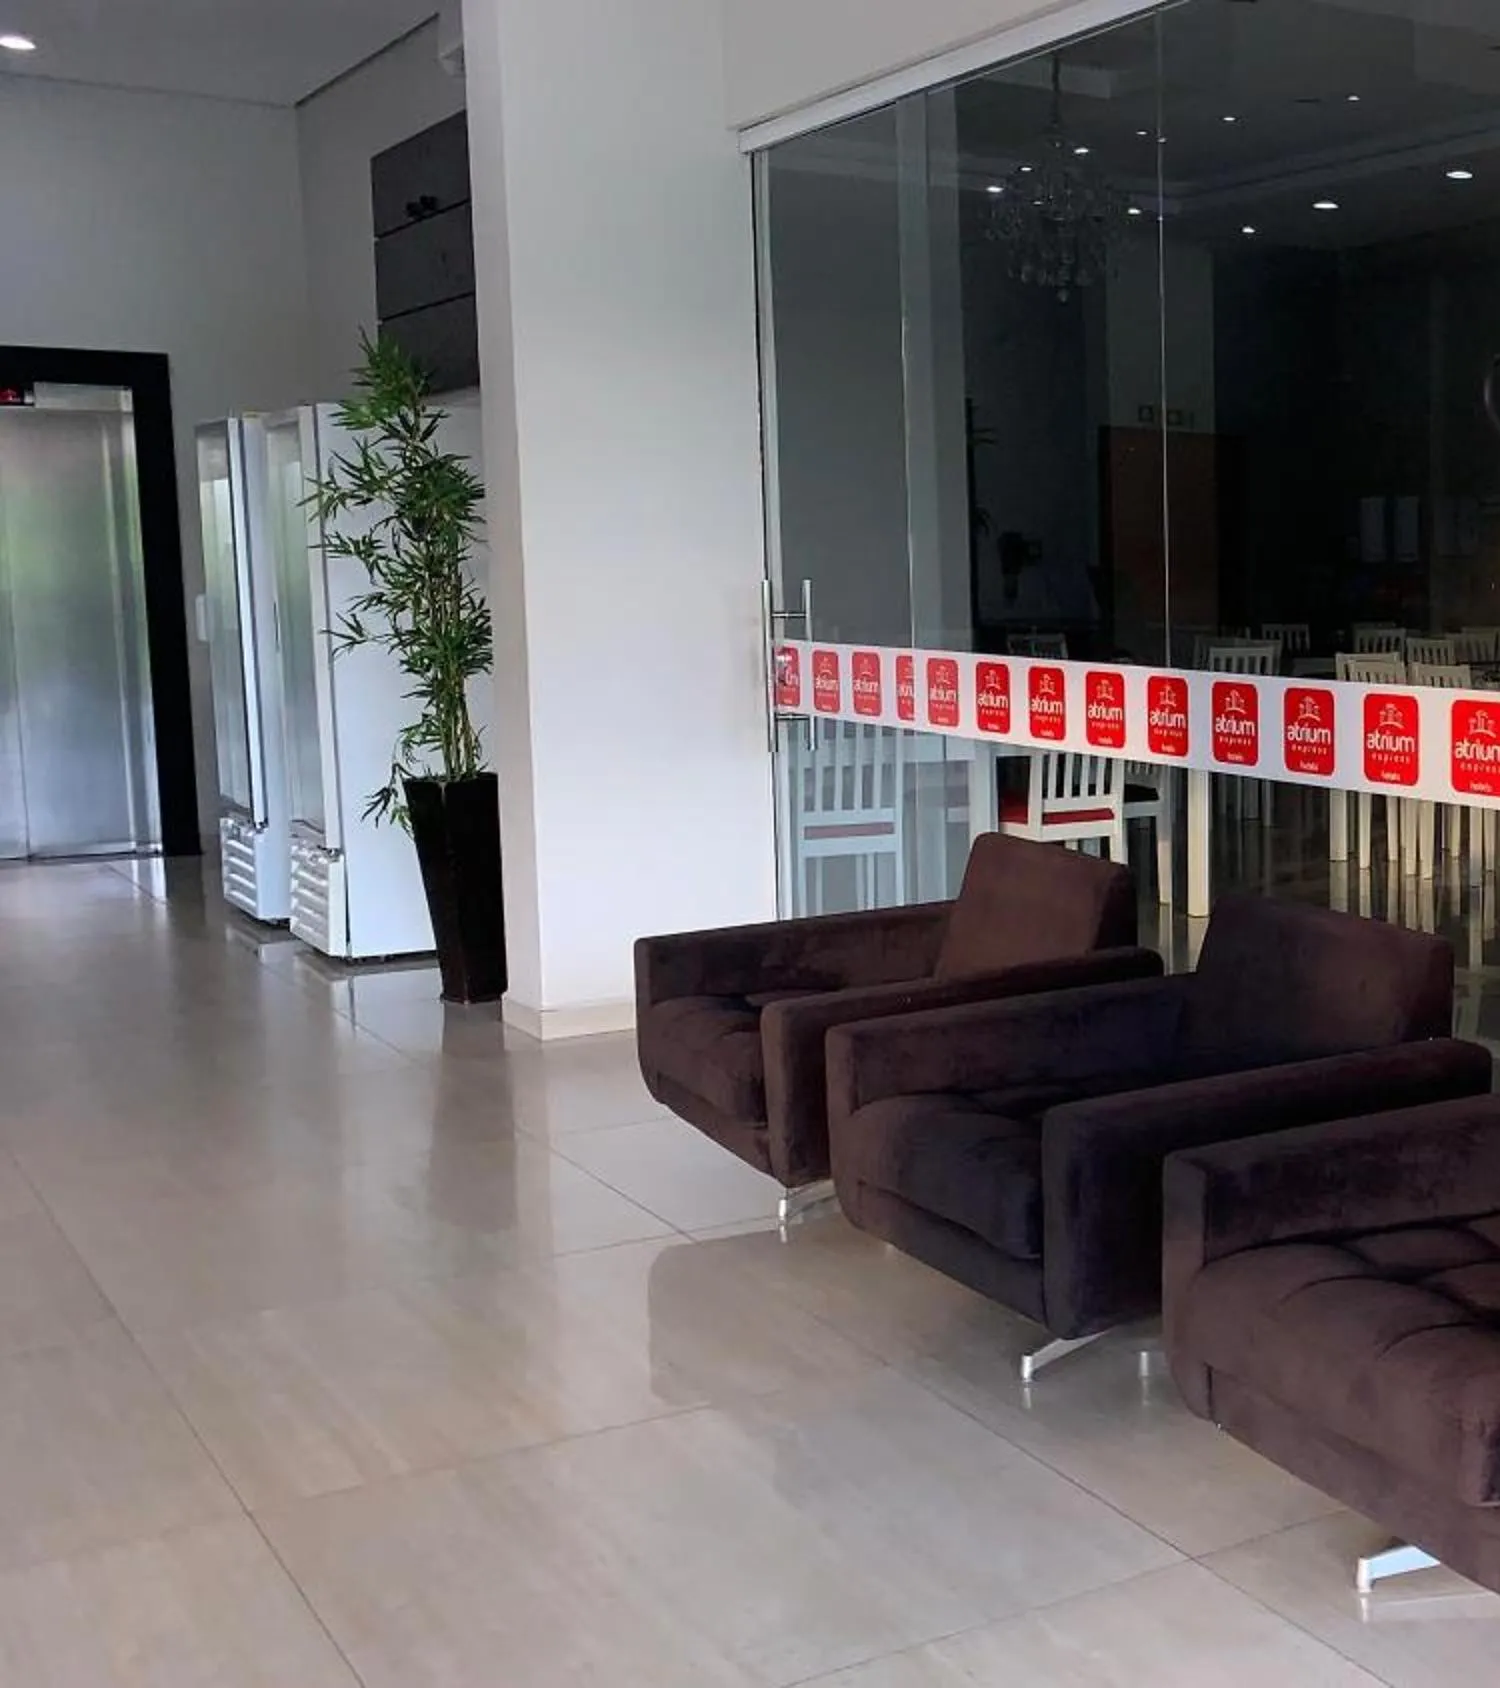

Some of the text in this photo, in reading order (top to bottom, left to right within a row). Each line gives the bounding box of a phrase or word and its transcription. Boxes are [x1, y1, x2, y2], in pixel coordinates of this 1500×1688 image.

[978, 691, 1008, 709] atrium
[1030, 695, 1063, 714] atrium
[1088, 702, 1123, 720] atrium
[1150, 708, 1186, 729] atrium
[1215, 714, 1255, 736] atrium
[1287, 722, 1331, 745] atrium
[1367, 729, 1415, 752] atrium
